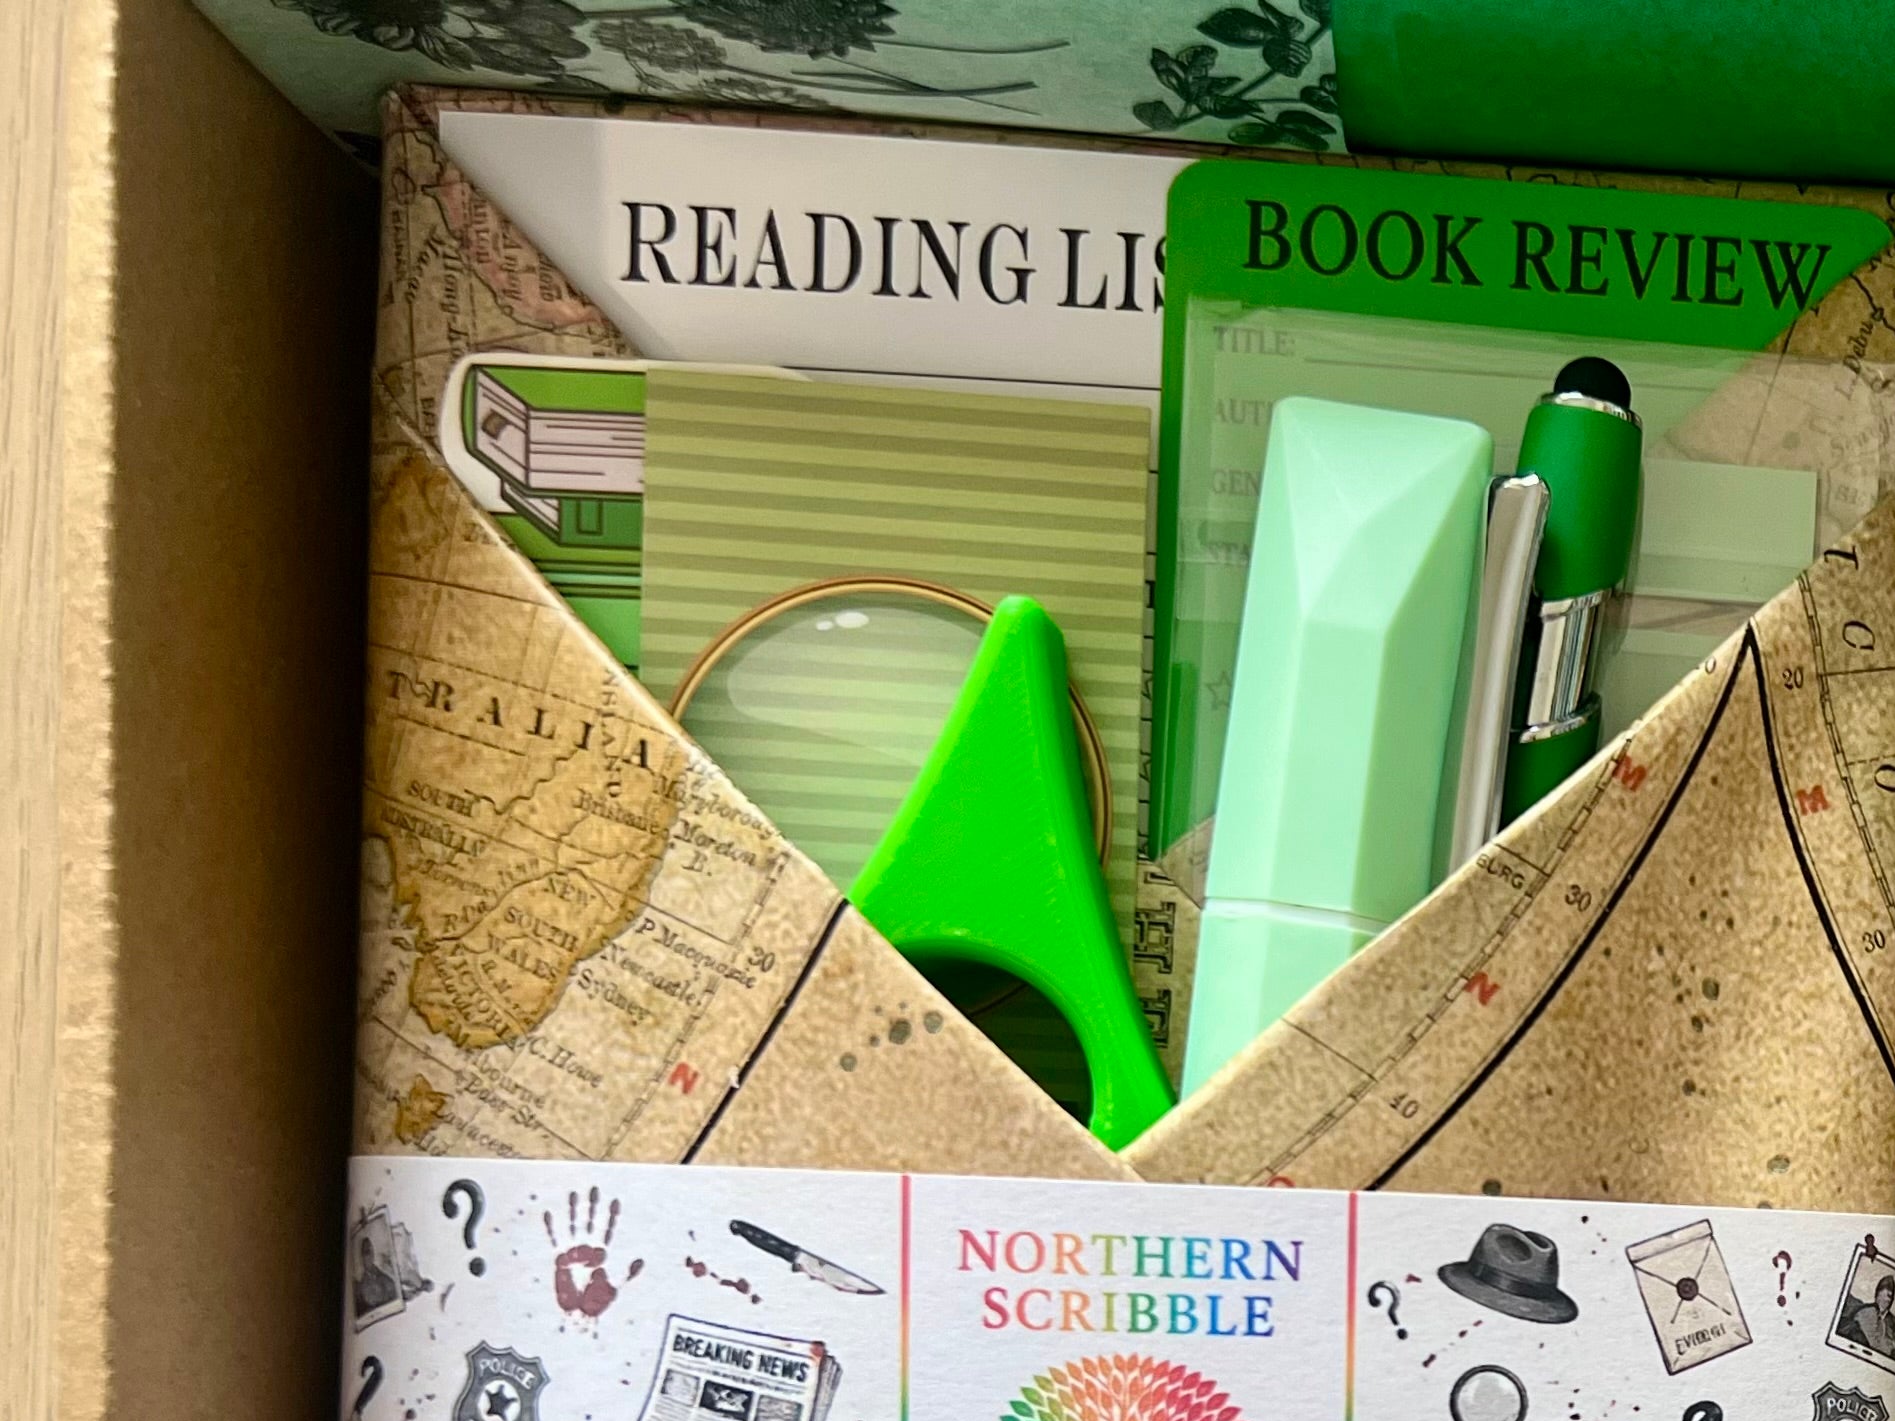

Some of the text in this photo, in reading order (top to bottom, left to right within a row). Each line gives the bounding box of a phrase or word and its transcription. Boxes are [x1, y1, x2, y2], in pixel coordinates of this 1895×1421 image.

[620, 200, 1037, 305] READING
[1244, 200, 1832, 312] BOOK REVIEW
[1212, 324, 1296, 357] TITLE:
[1782, 668, 1805, 692] 20
[1565, 883, 1592, 912] 30
[746, 928, 776, 974] 30
[1861, 928, 1887, 956] 30
[955, 1227, 1305, 1282] NORTHERN
[981, 1286, 1276, 1338] SCRIBBLE
[672, 1333, 754, 1371] BREAKING
[757, 1353, 811, 1384] NEWS
